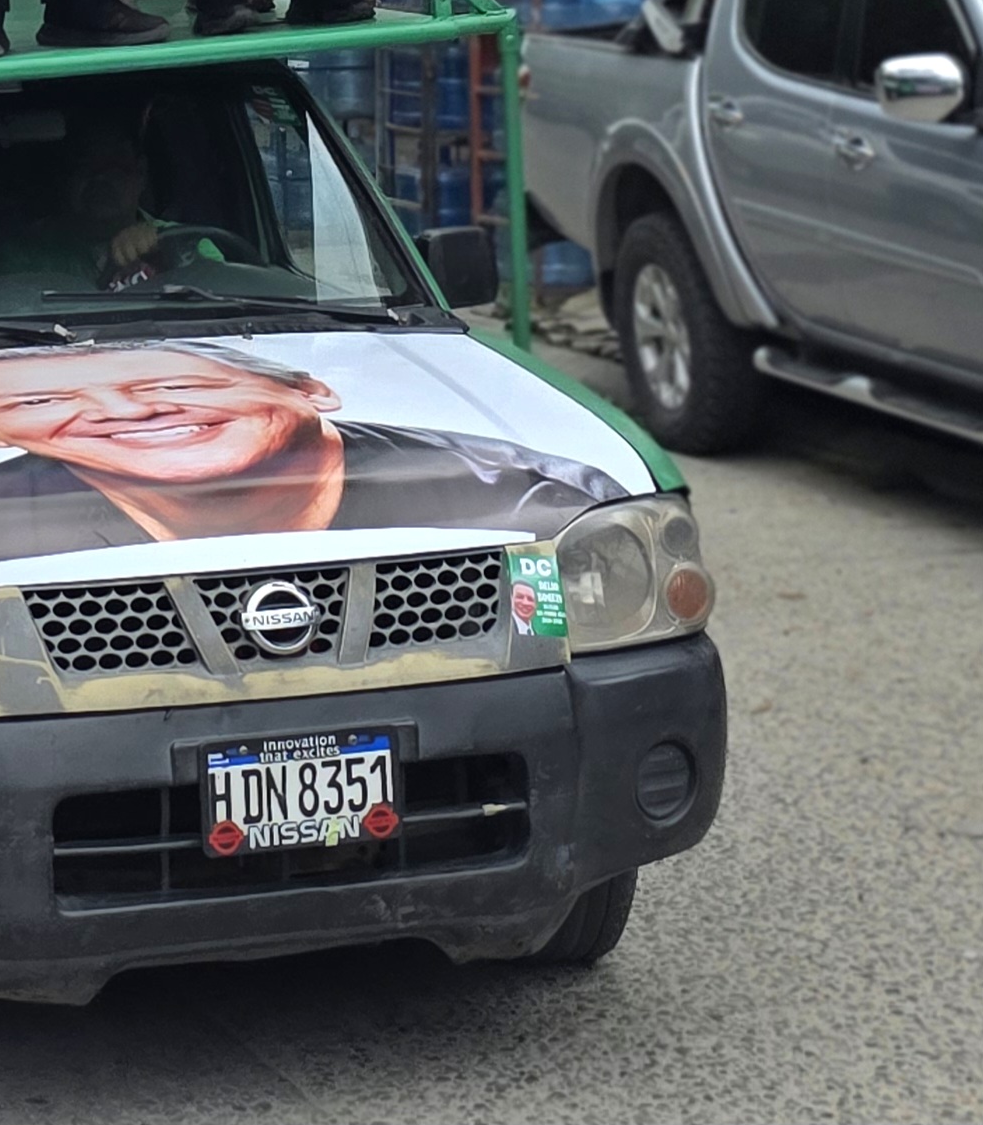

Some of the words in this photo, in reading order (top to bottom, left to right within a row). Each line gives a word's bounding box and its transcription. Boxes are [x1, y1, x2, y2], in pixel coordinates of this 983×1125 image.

[519, 558, 552, 576] DC
[252, 611, 314, 626] NISSAN
[263, 735, 336, 752] Innovation
[259, 750, 288, 764] that
[293, 745, 341, 760] excites
[211, 765, 289, 825] HDN
[298, 755, 392, 818] 8351
[248, 815, 361, 850] NISSAN
